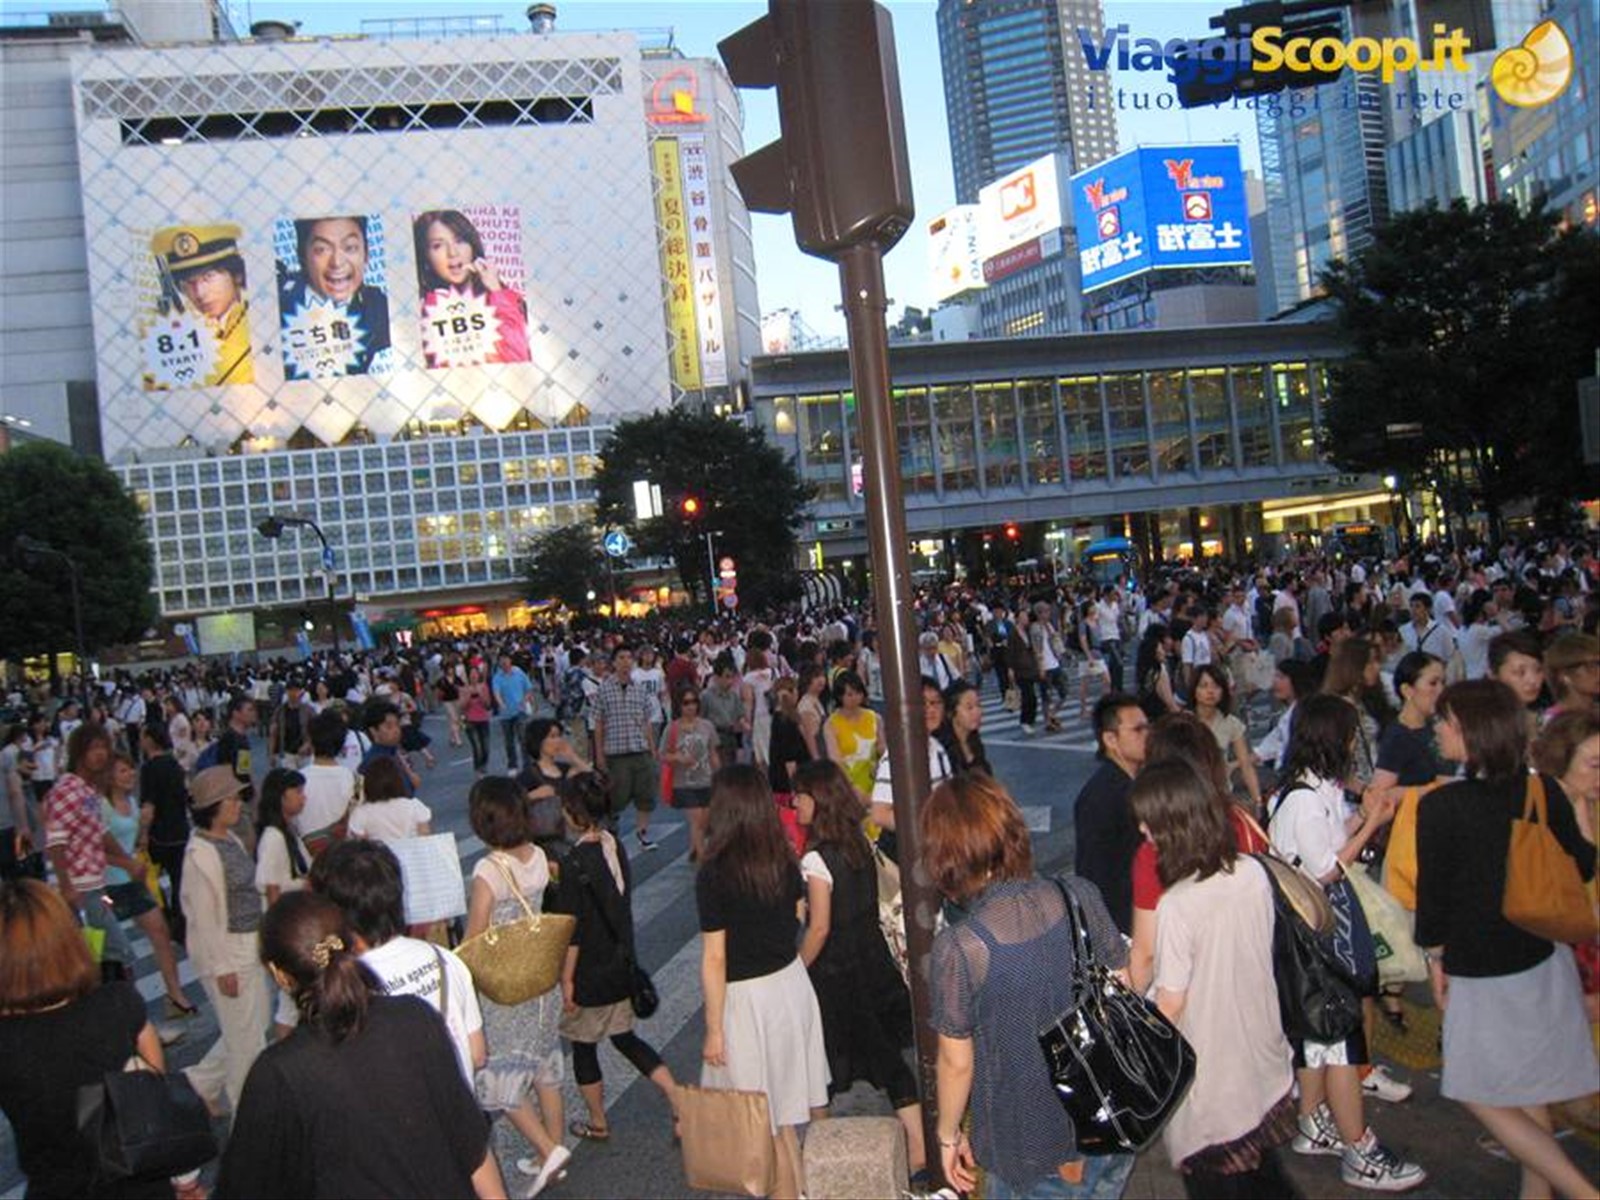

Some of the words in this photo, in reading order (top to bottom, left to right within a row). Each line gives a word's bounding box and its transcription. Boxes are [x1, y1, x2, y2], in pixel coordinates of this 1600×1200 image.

[1156, 221, 1243, 252] 武富士
[1079, 231, 1144, 276] 武富士
[289, 319, 353, 349] こち亀
[432, 313, 486, 338] TBS
[156, 328, 200, 354] 8.1
